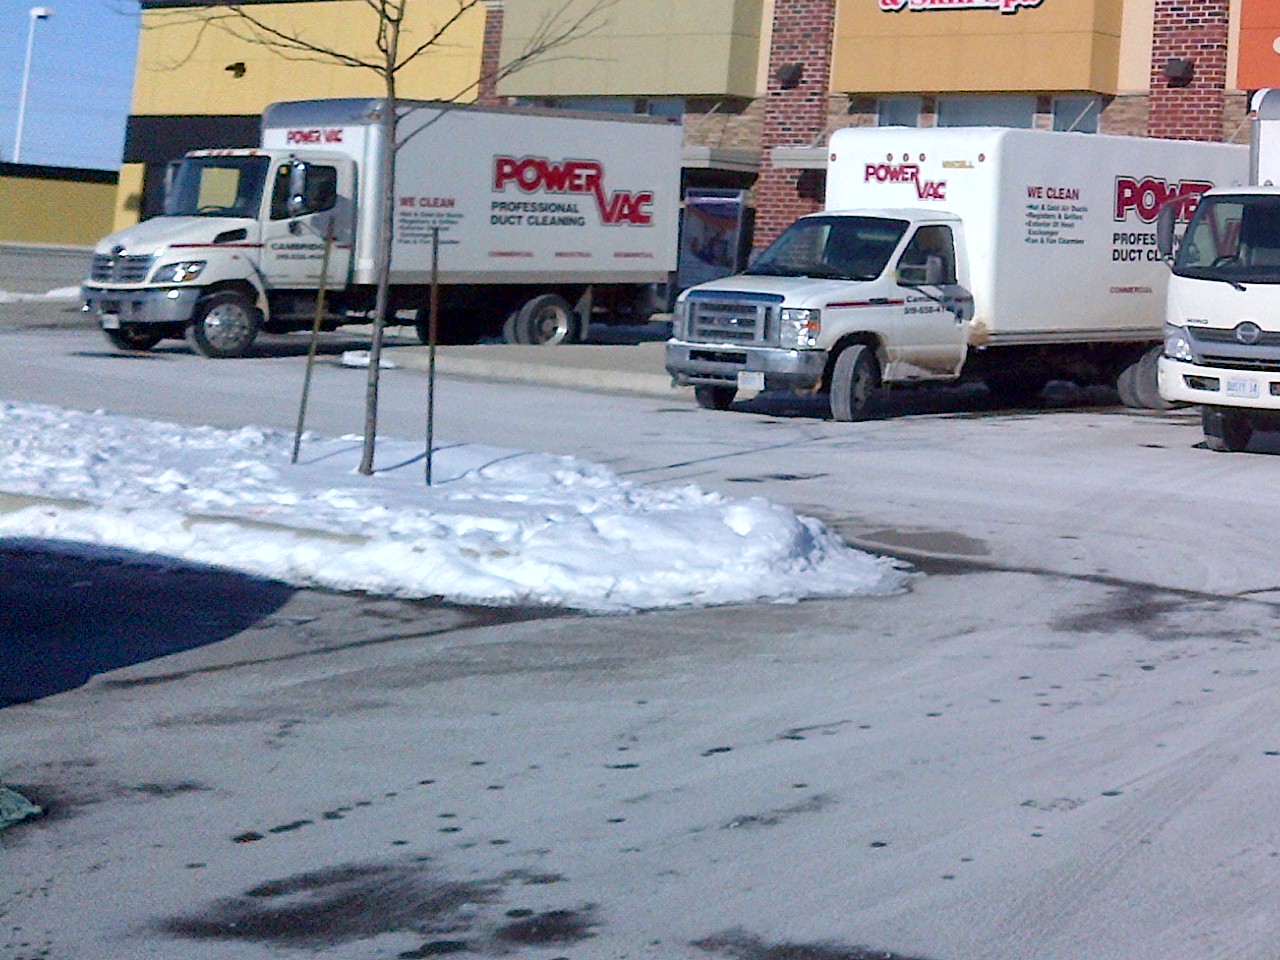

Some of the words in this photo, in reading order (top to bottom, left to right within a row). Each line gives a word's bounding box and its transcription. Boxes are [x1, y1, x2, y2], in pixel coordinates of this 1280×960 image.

[864, 163, 920, 183] POWER
[915, 180, 947, 201] VAC
[491, 155, 603, 195] POWER
[593, 190, 654, 227] VAC
[1027, 186, 1042, 198] WE
[1047, 187, 1079, 200] CLEAN
[491, 202, 579, 213] PROFESSIONAL
[491, 215, 523, 226] DUCT
[527, 216, 586, 227] CLEANING
[1112, 249, 1142, 261] DUCT
